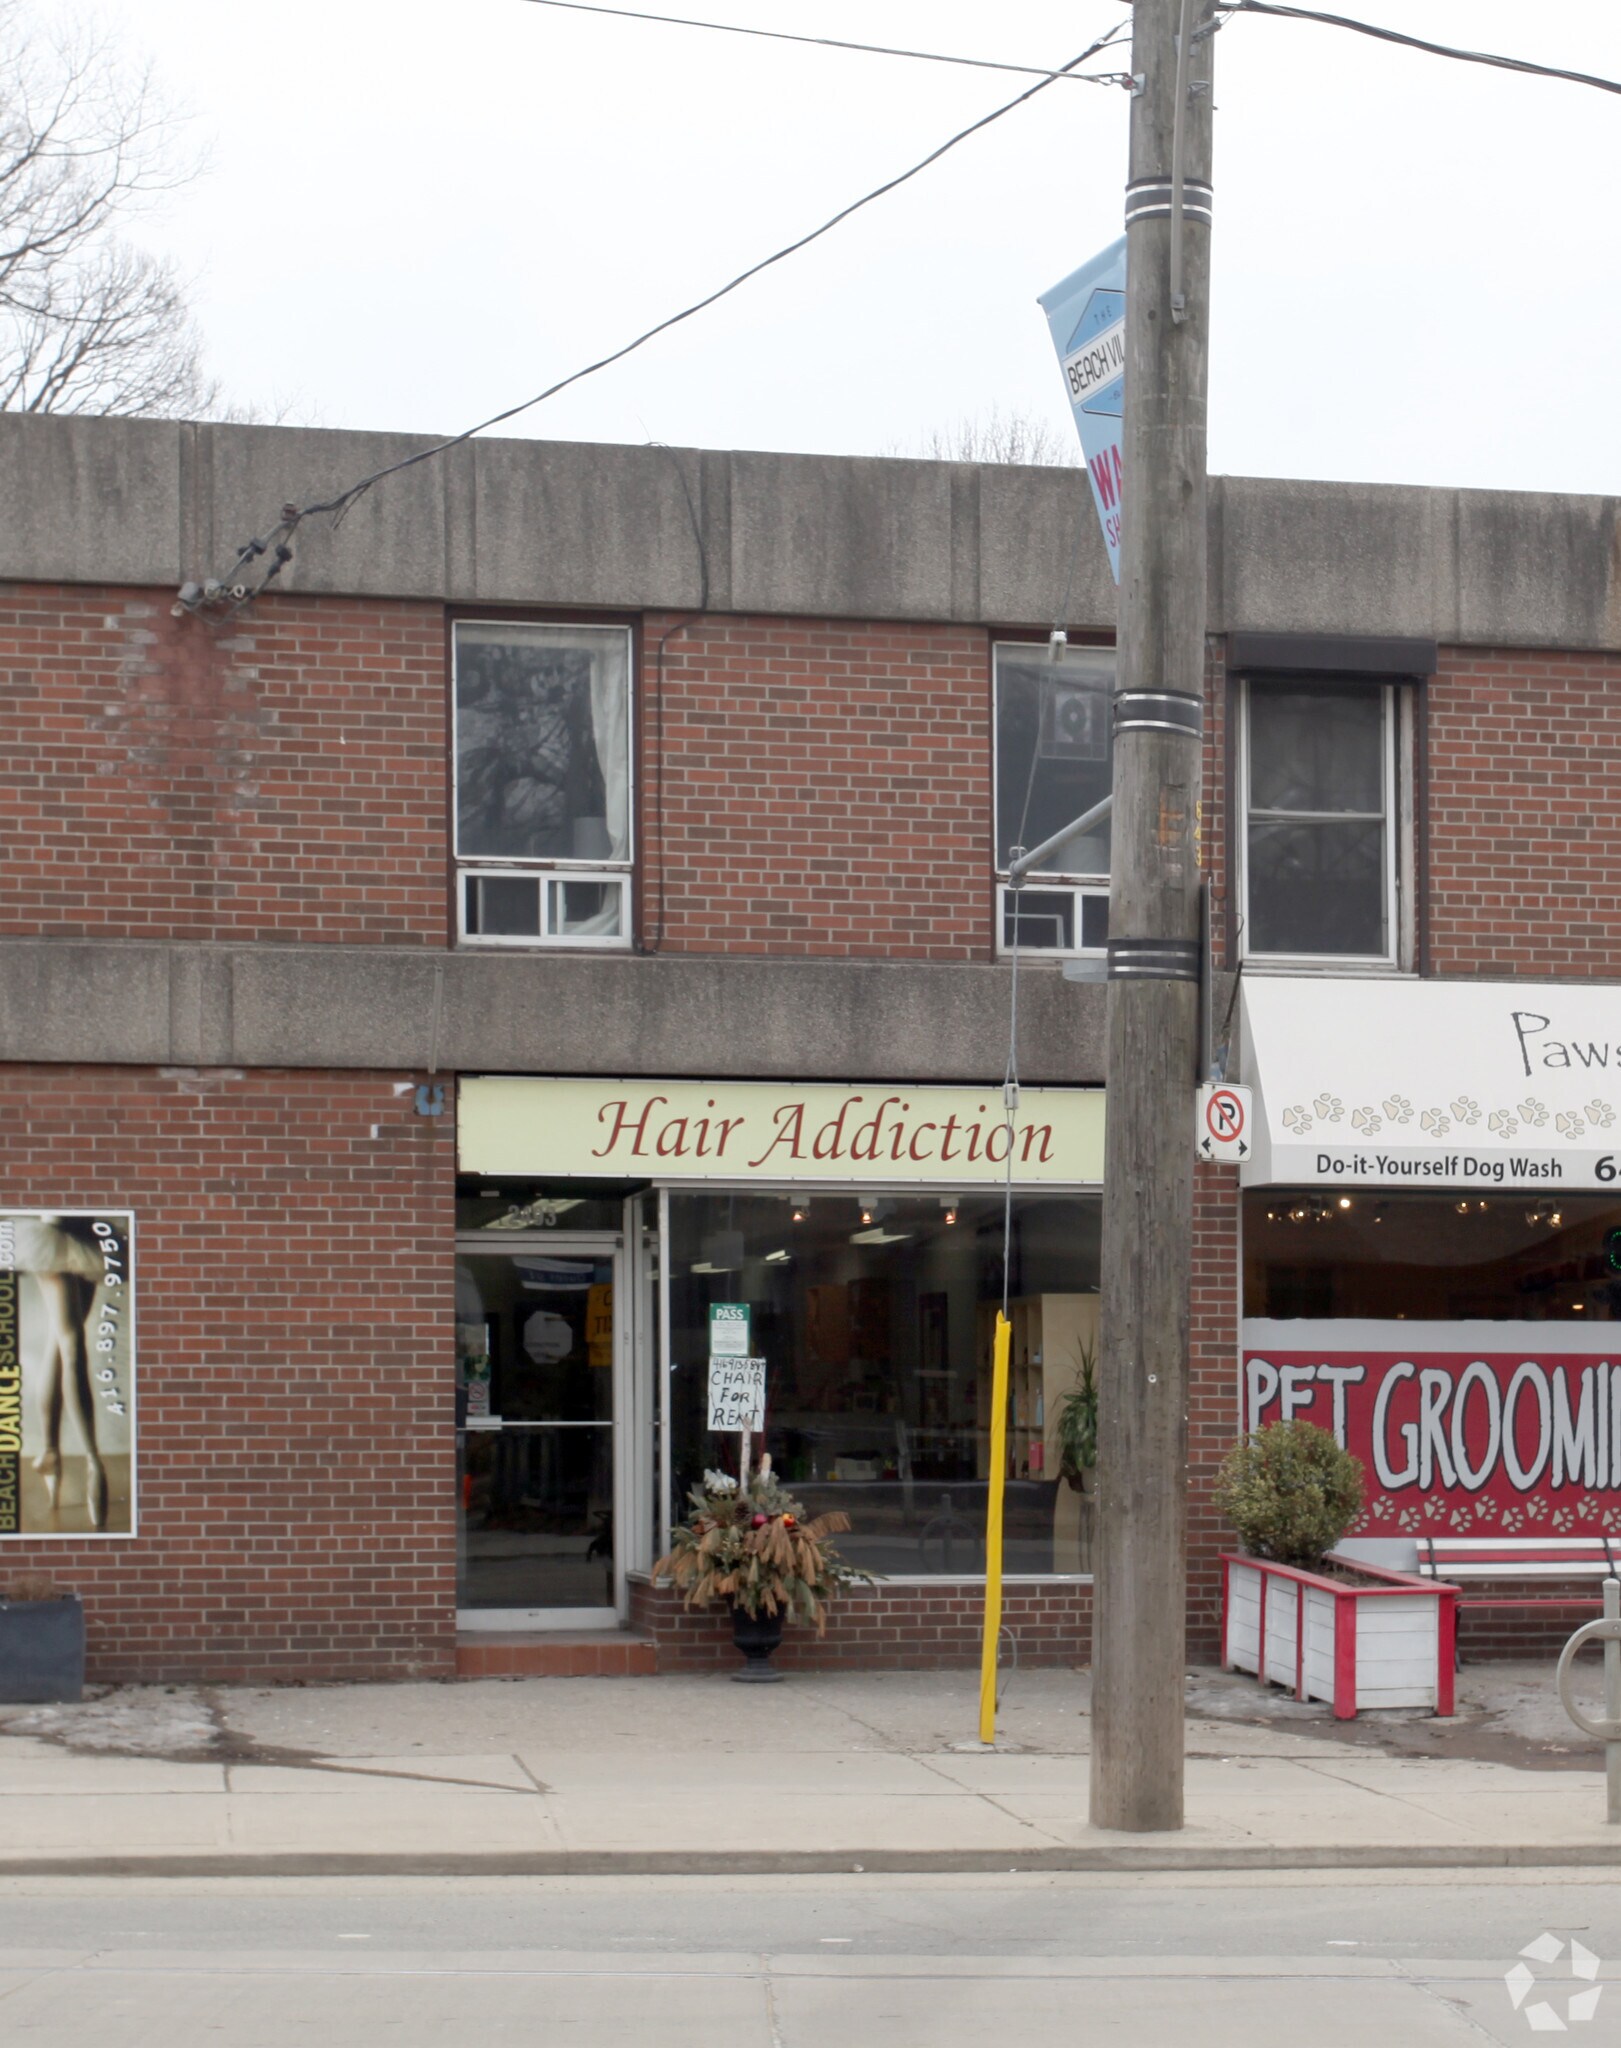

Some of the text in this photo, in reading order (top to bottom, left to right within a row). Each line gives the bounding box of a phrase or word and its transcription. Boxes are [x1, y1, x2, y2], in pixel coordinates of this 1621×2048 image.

[1067, 332, 1125, 395] BEACH VIL
[1510, 1011, 1621, 1077] Paw
[591, 1095, 1055, 1168] Hair Addiction
[1316, 1154, 1621, 1182] Do-it-Yourself Dog Wash 6
[716, 1308, 745, 1320] PASS
[711, 1370, 763, 1386] CHAIR
[720, 1387, 750, 1403] FOR
[712, 1407, 760, 1427] RENT
